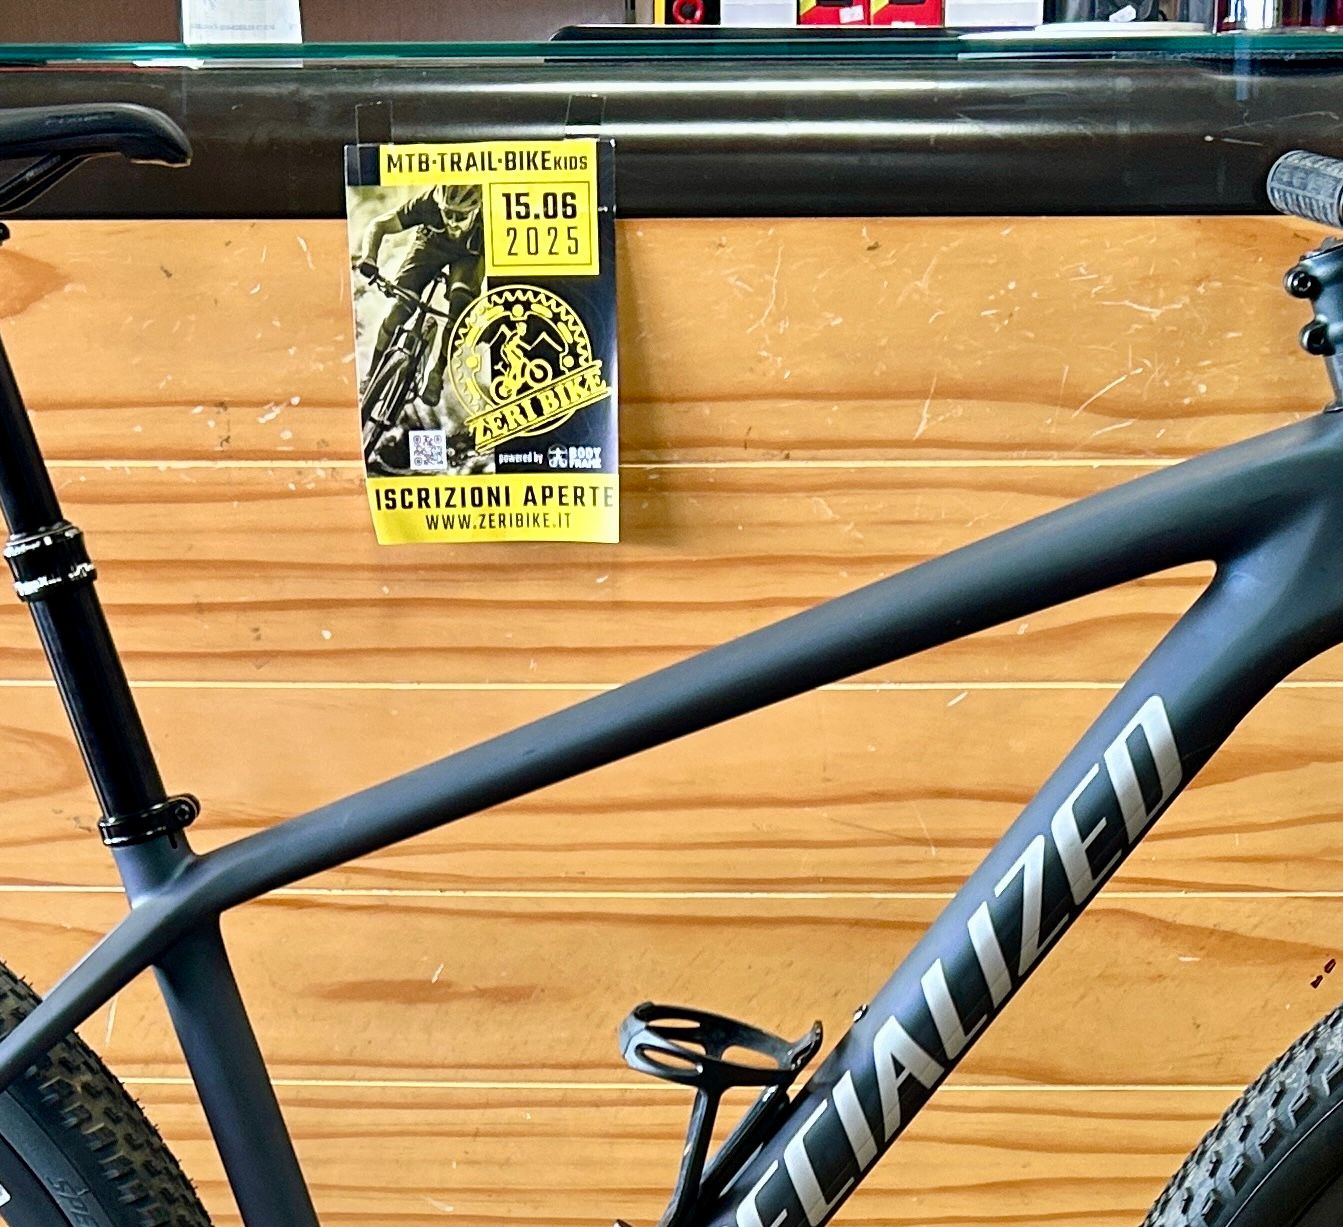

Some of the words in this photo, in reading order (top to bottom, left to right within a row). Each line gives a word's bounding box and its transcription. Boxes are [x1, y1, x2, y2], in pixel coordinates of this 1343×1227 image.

[502, 191, 578, 221] 15.06
[506, 226, 580, 257] 2025
[470, 404, 537, 443] ZERI
[543, 367, 608, 417] BIKE
[376, 485, 511, 511] ISCRIZIONI
[522, 485, 614, 508] APERTE
[425, 512, 572, 531] WWW.ZERIBIKE.IT
